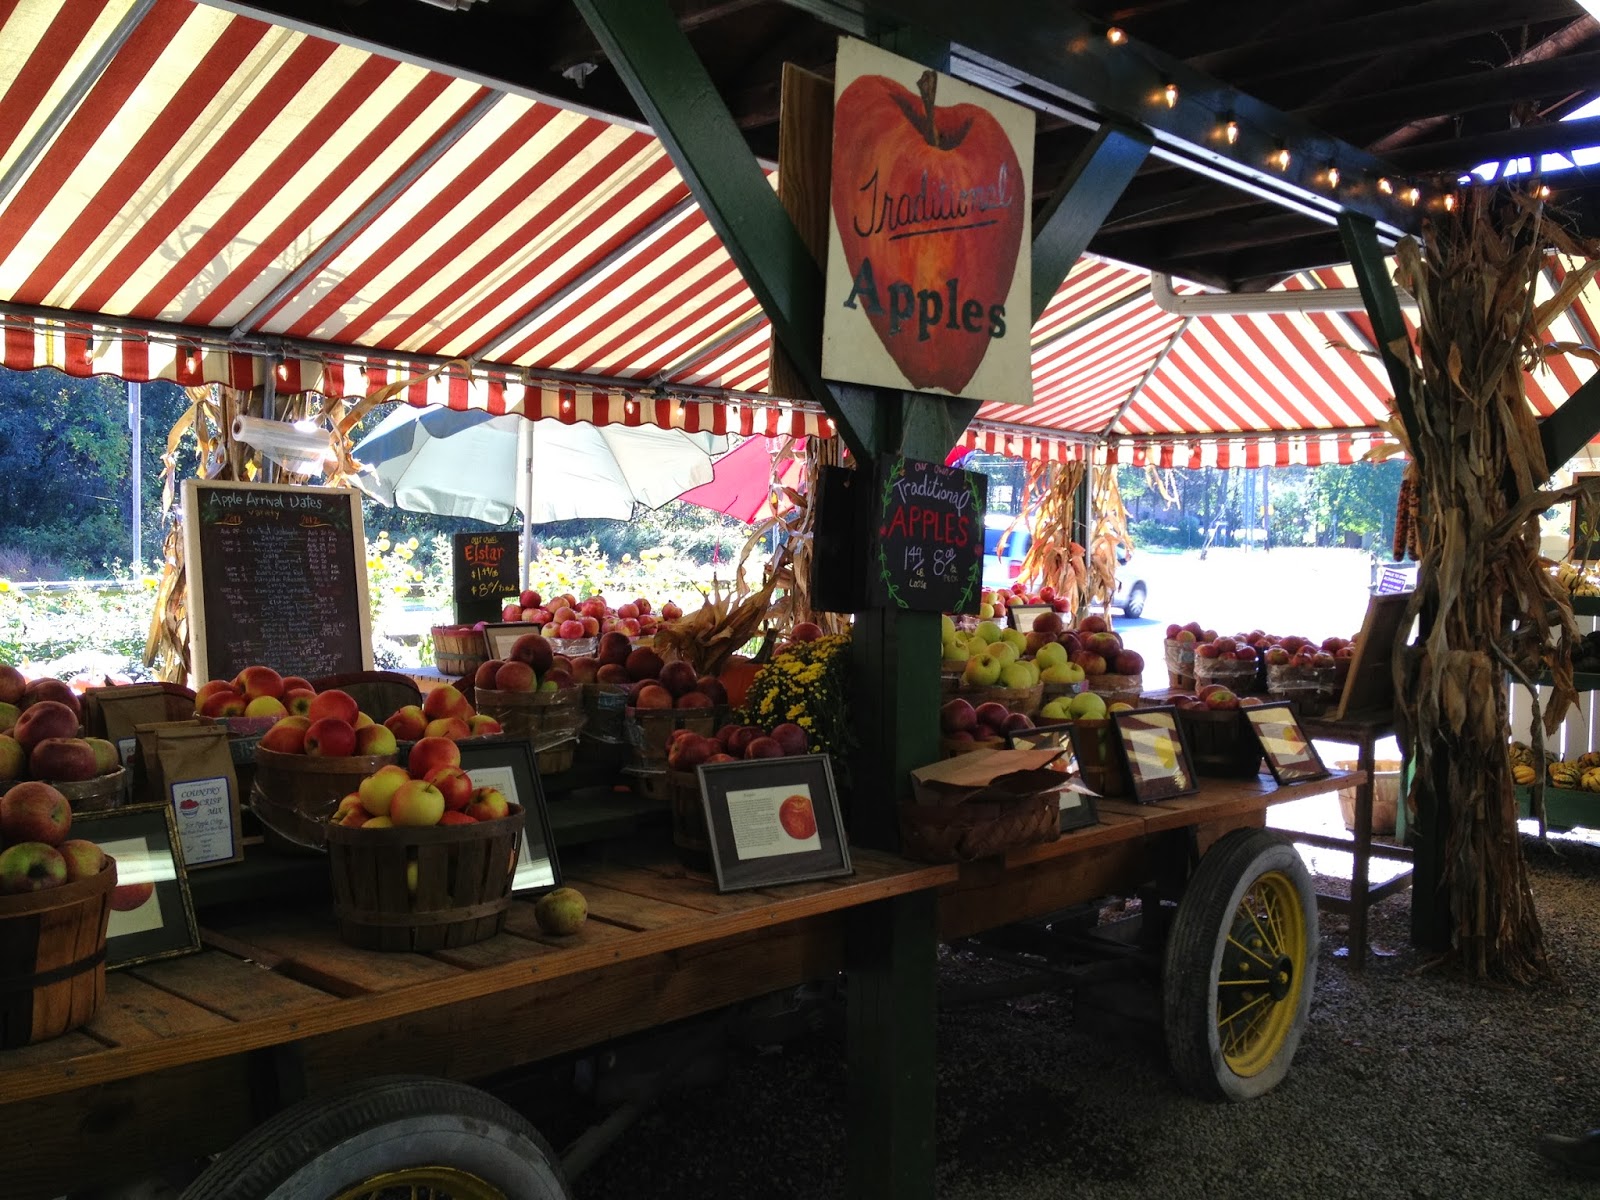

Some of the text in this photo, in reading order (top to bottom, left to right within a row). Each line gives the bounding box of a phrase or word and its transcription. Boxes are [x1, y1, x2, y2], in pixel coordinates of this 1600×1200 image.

[854, 162, 1012, 237] Traditional
[844, 257, 1006, 341] Apples
[209, 491, 323, 509] Apple Arrival Dates
[892, 473, 971, 517] Traditional
[887, 504, 970, 547] APPLES
[464, 544, 505, 561] Elstar
[181, 786, 222, 798] COUNTRY
[199, 797, 222, 806] CRISP
[207, 807, 224, 816] MIX
